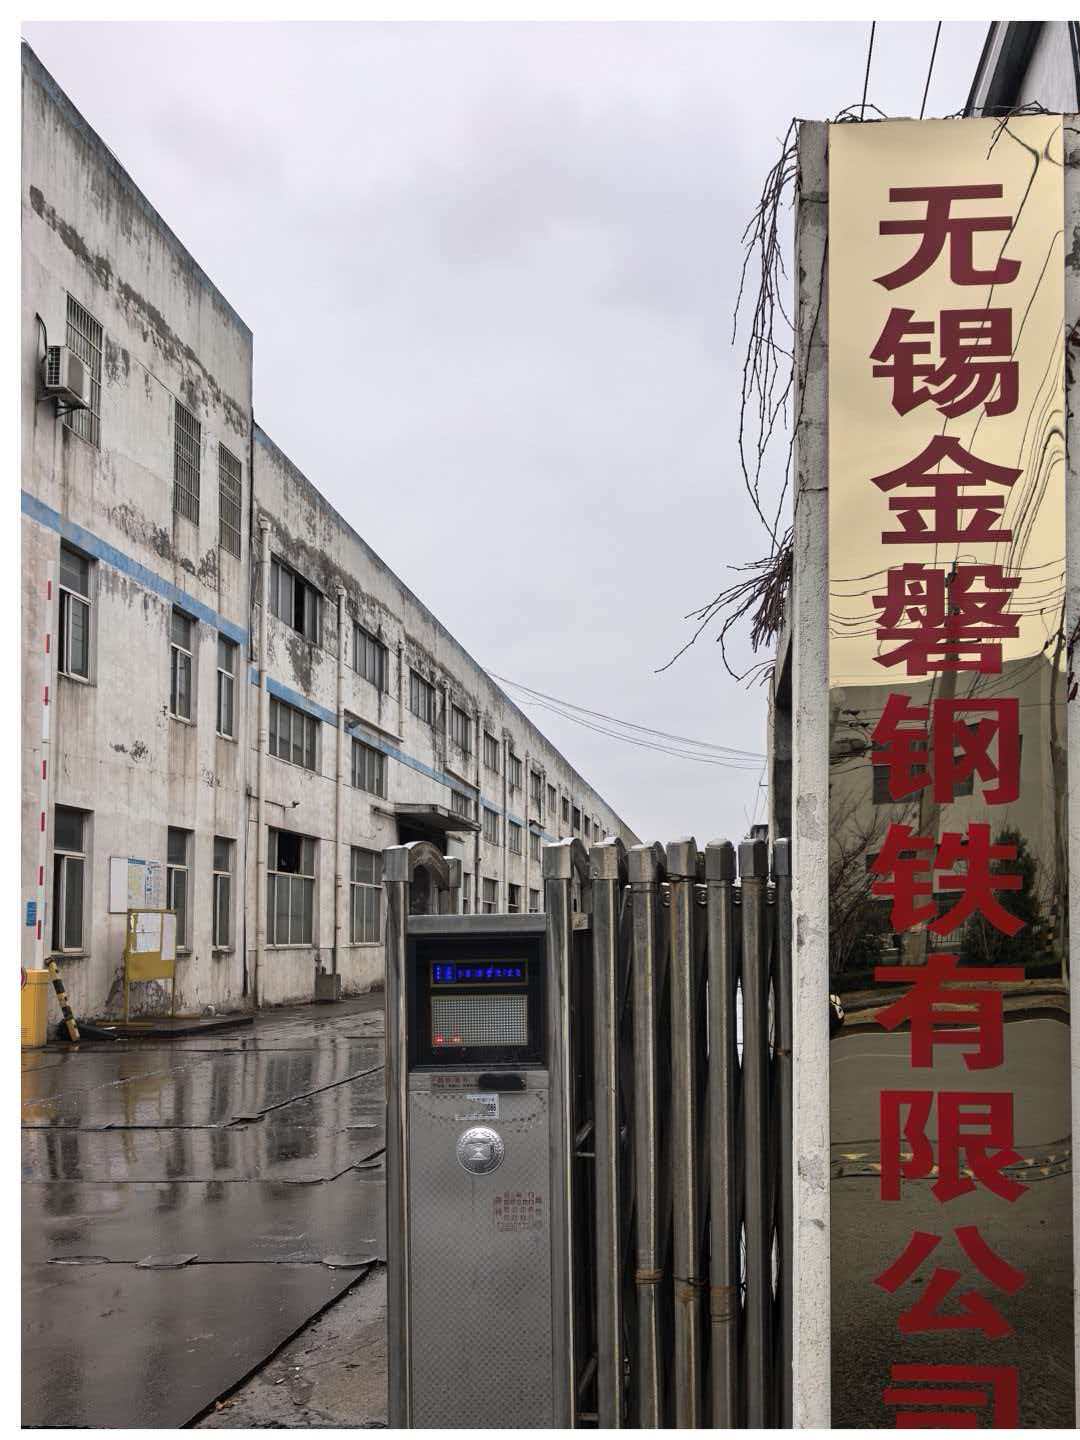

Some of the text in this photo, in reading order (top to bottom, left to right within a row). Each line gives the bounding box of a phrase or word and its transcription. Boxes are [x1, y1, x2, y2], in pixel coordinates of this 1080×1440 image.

[869, 184, 1025, 1428] 无锡金磐钢铁有限公司
